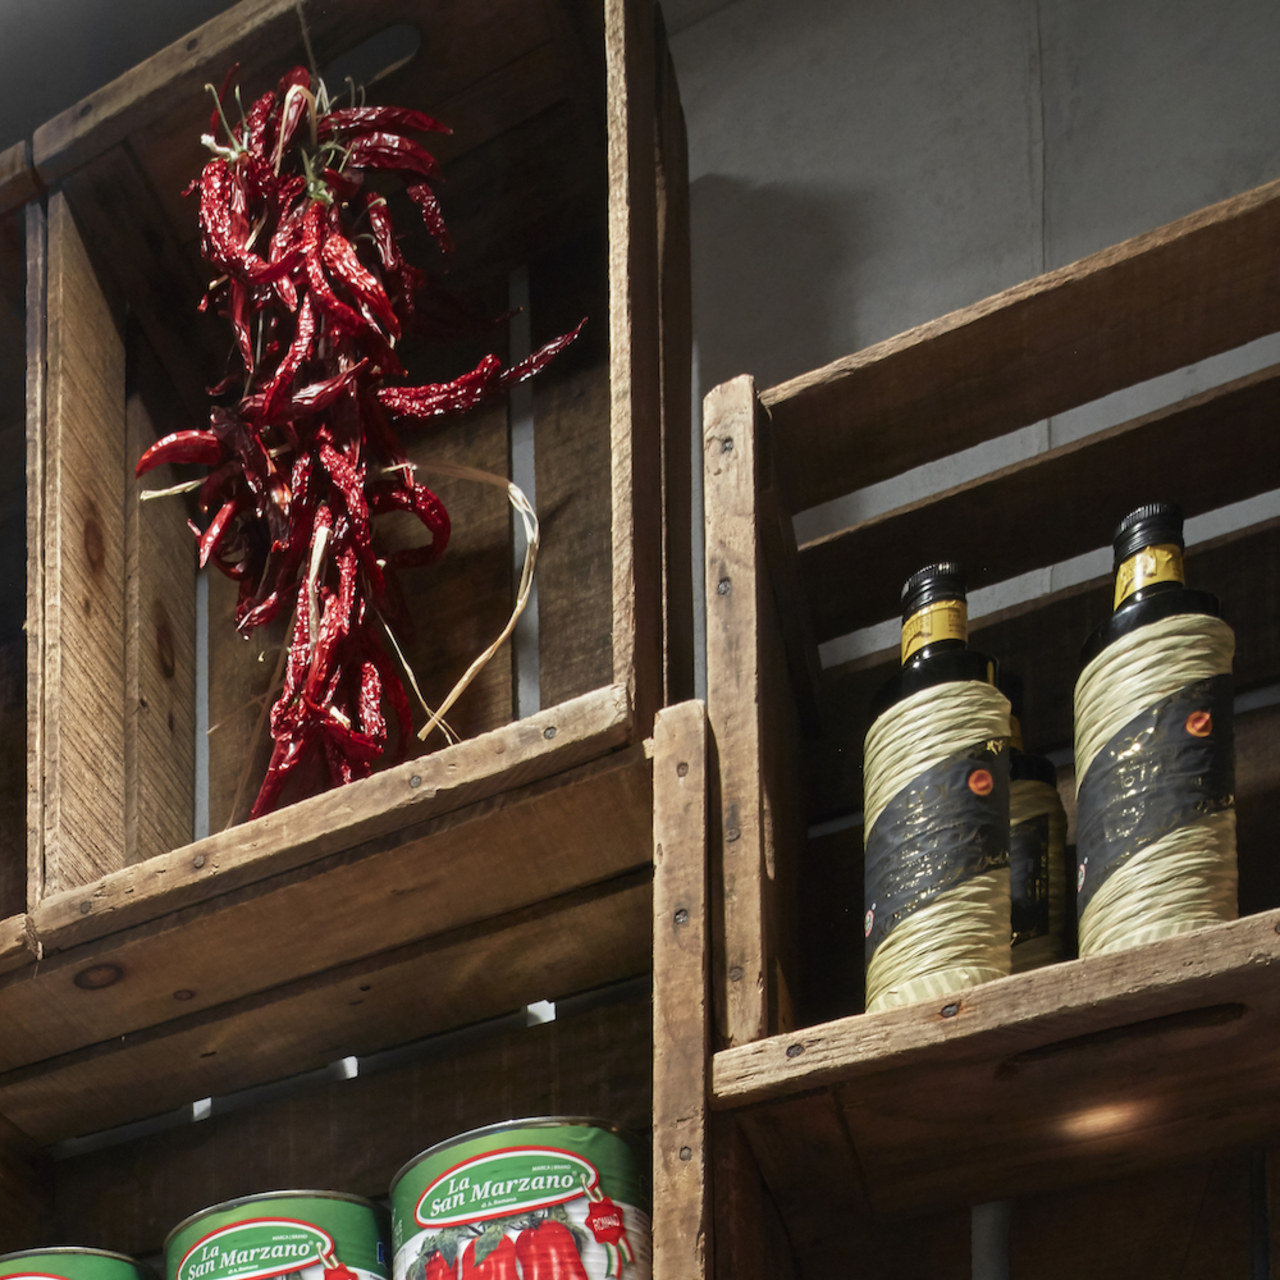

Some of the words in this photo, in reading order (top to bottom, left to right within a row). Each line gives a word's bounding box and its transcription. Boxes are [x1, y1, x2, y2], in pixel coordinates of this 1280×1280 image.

[430, 1194, 465, 1217] San
[470, 1173, 574, 1203] Marzano
[447, 1177, 470, 1195] La
[592, 1213, 621, 1232] ROMANO
[188, 1261, 215, 1280] San
[219, 1242, 310, 1269] Marzano
[201, 1245, 220, 1262] La
